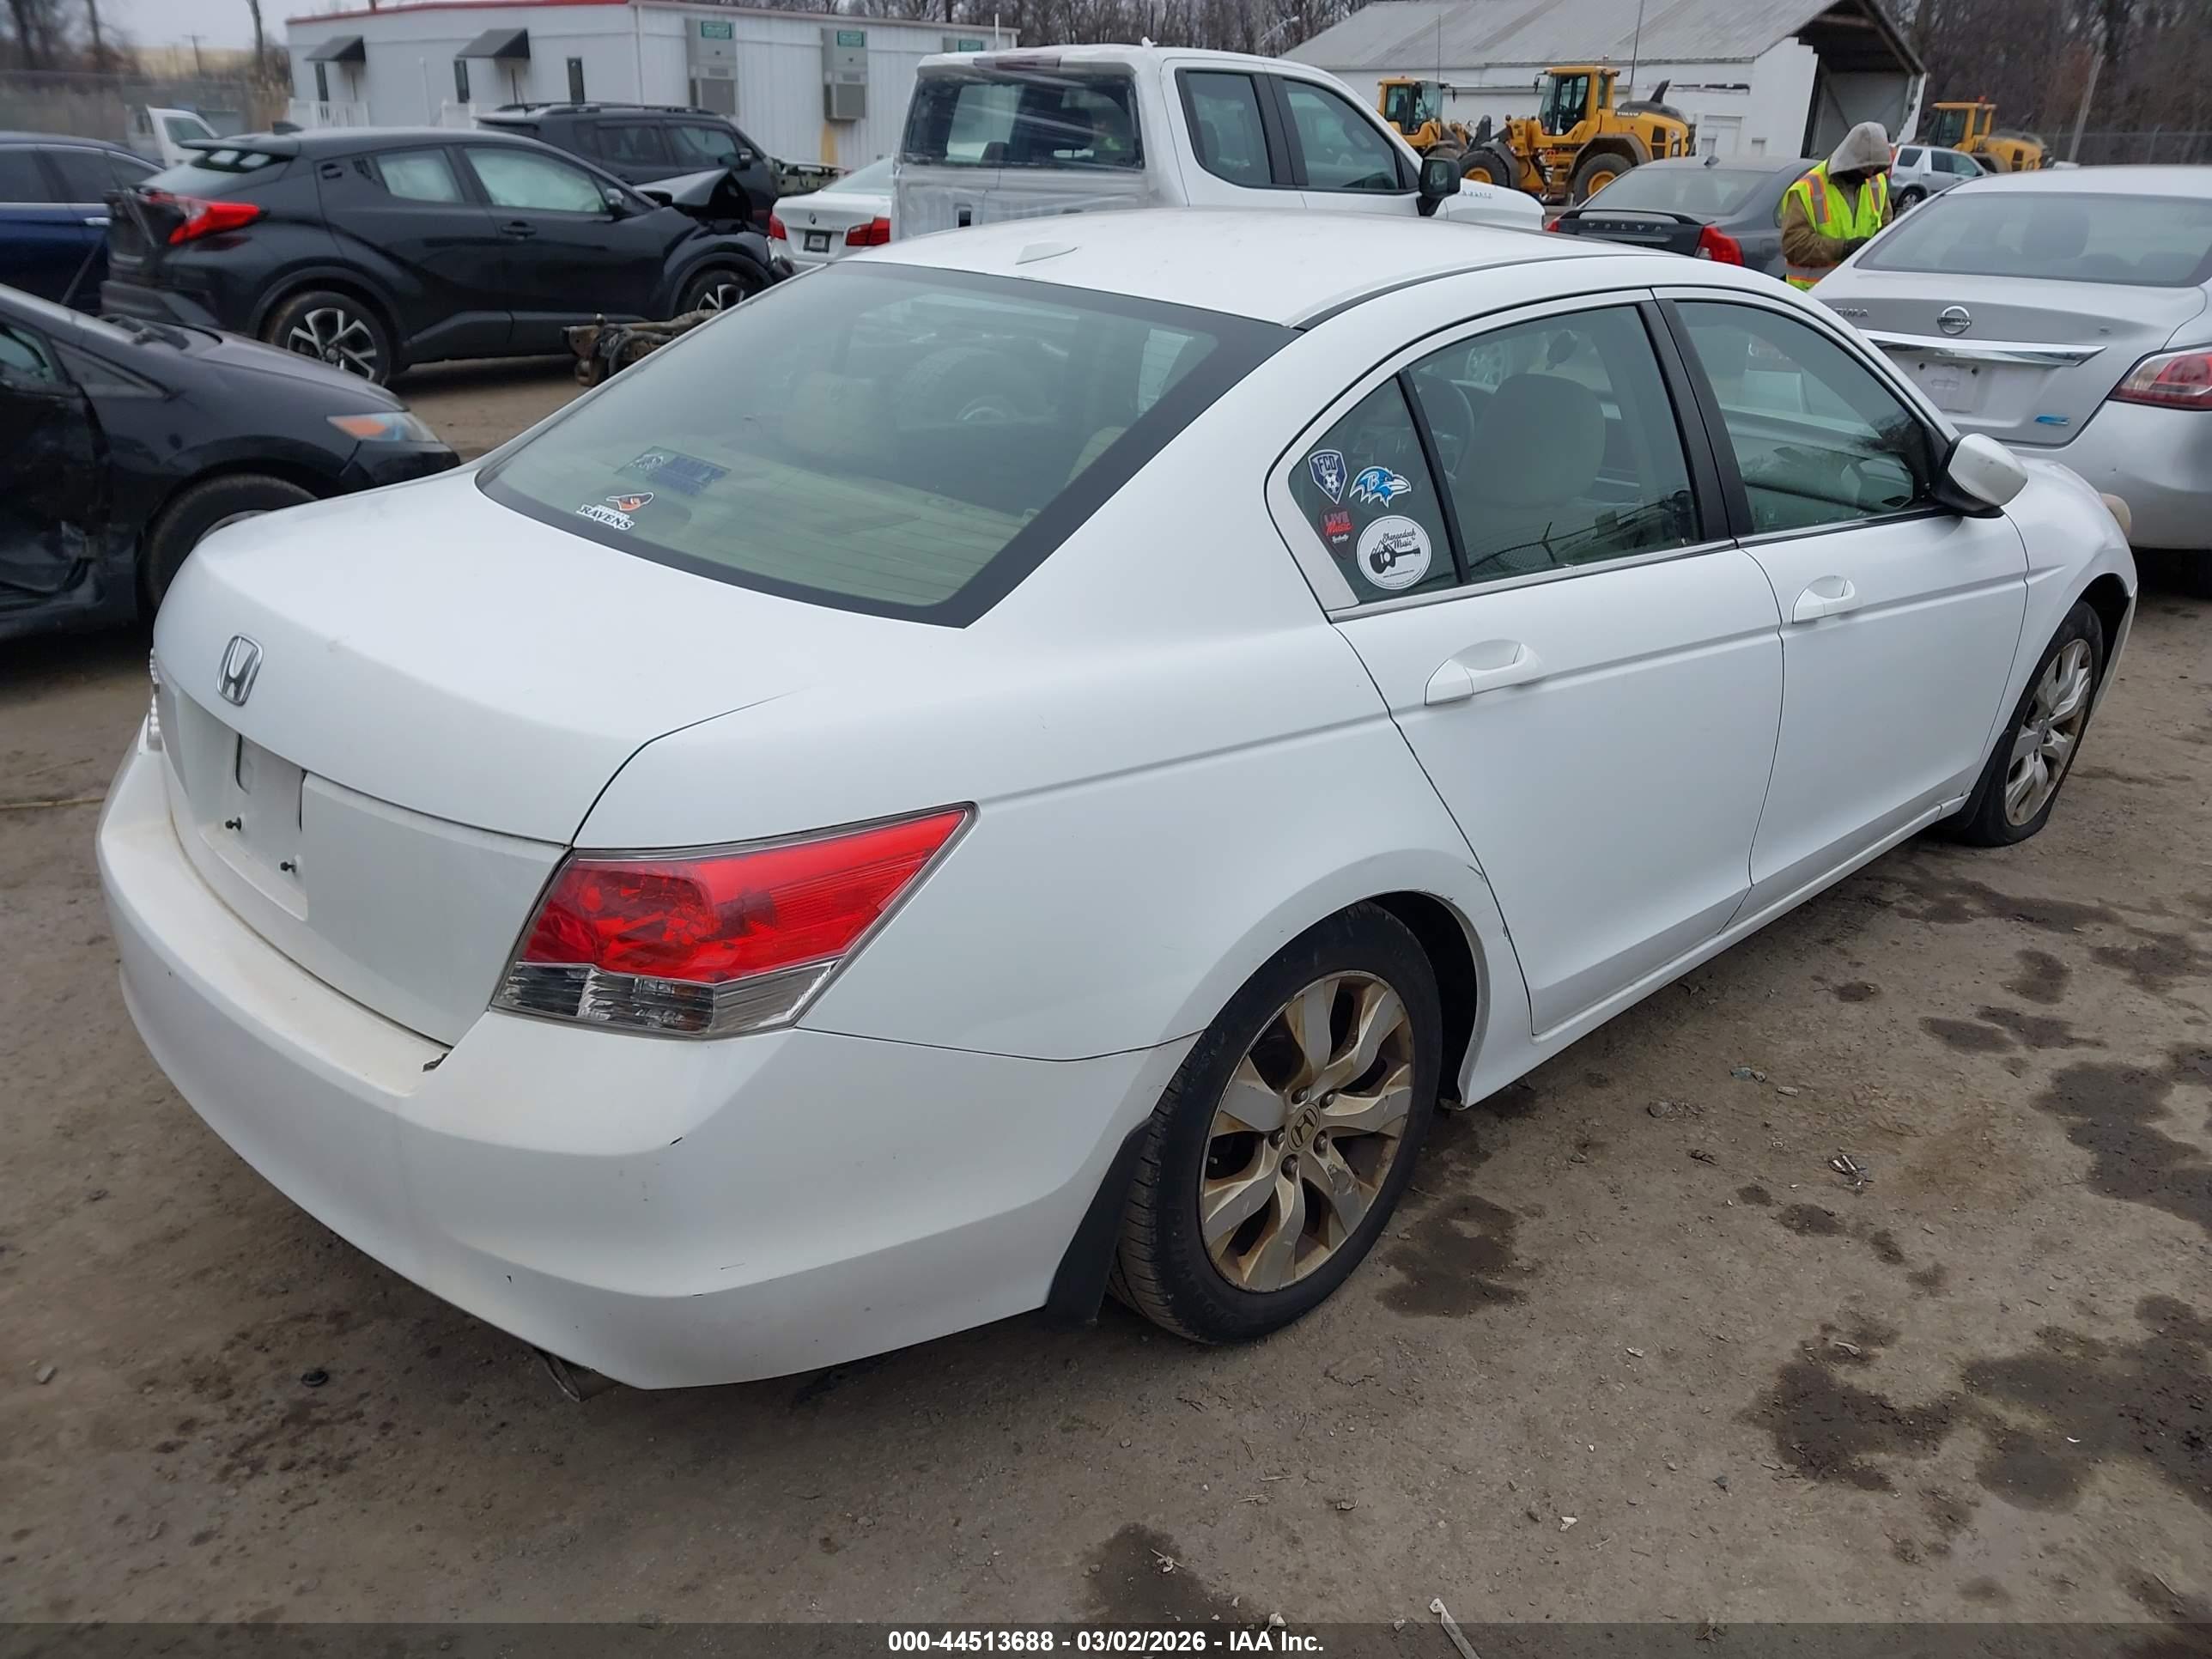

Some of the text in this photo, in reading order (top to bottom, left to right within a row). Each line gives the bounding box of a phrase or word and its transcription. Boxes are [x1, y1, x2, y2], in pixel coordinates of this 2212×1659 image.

[1589, 222, 1662, 232] VOLVO
[1834, 307, 1869, 318] TIMA
[1316, 455, 1337, 473] FCD
[580, 505, 633, 528] RAVENS
[1390, 538, 1413, 549] Music
